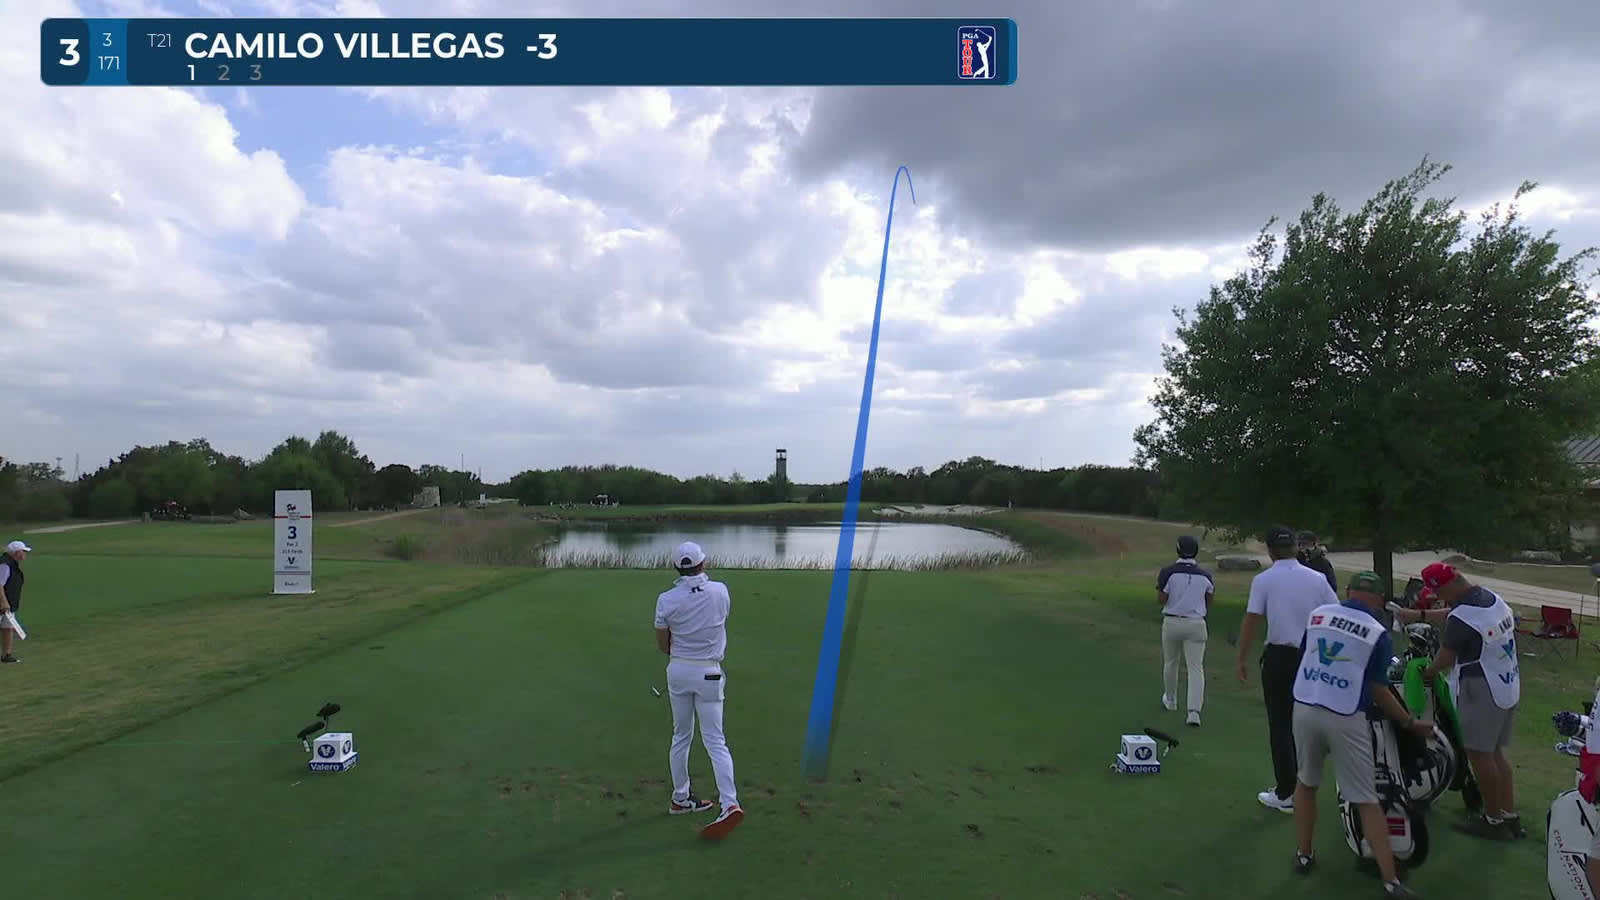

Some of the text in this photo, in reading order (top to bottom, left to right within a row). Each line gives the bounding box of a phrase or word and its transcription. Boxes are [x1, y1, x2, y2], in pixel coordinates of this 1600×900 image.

[287, 526, 297, 540] 3
[1329, 616, 1371, 639] REITAN
[1303, 667, 1349, 689] Valero
[310, 763, 340, 771] Valero
[1128, 765, 1158, 773] Valero
